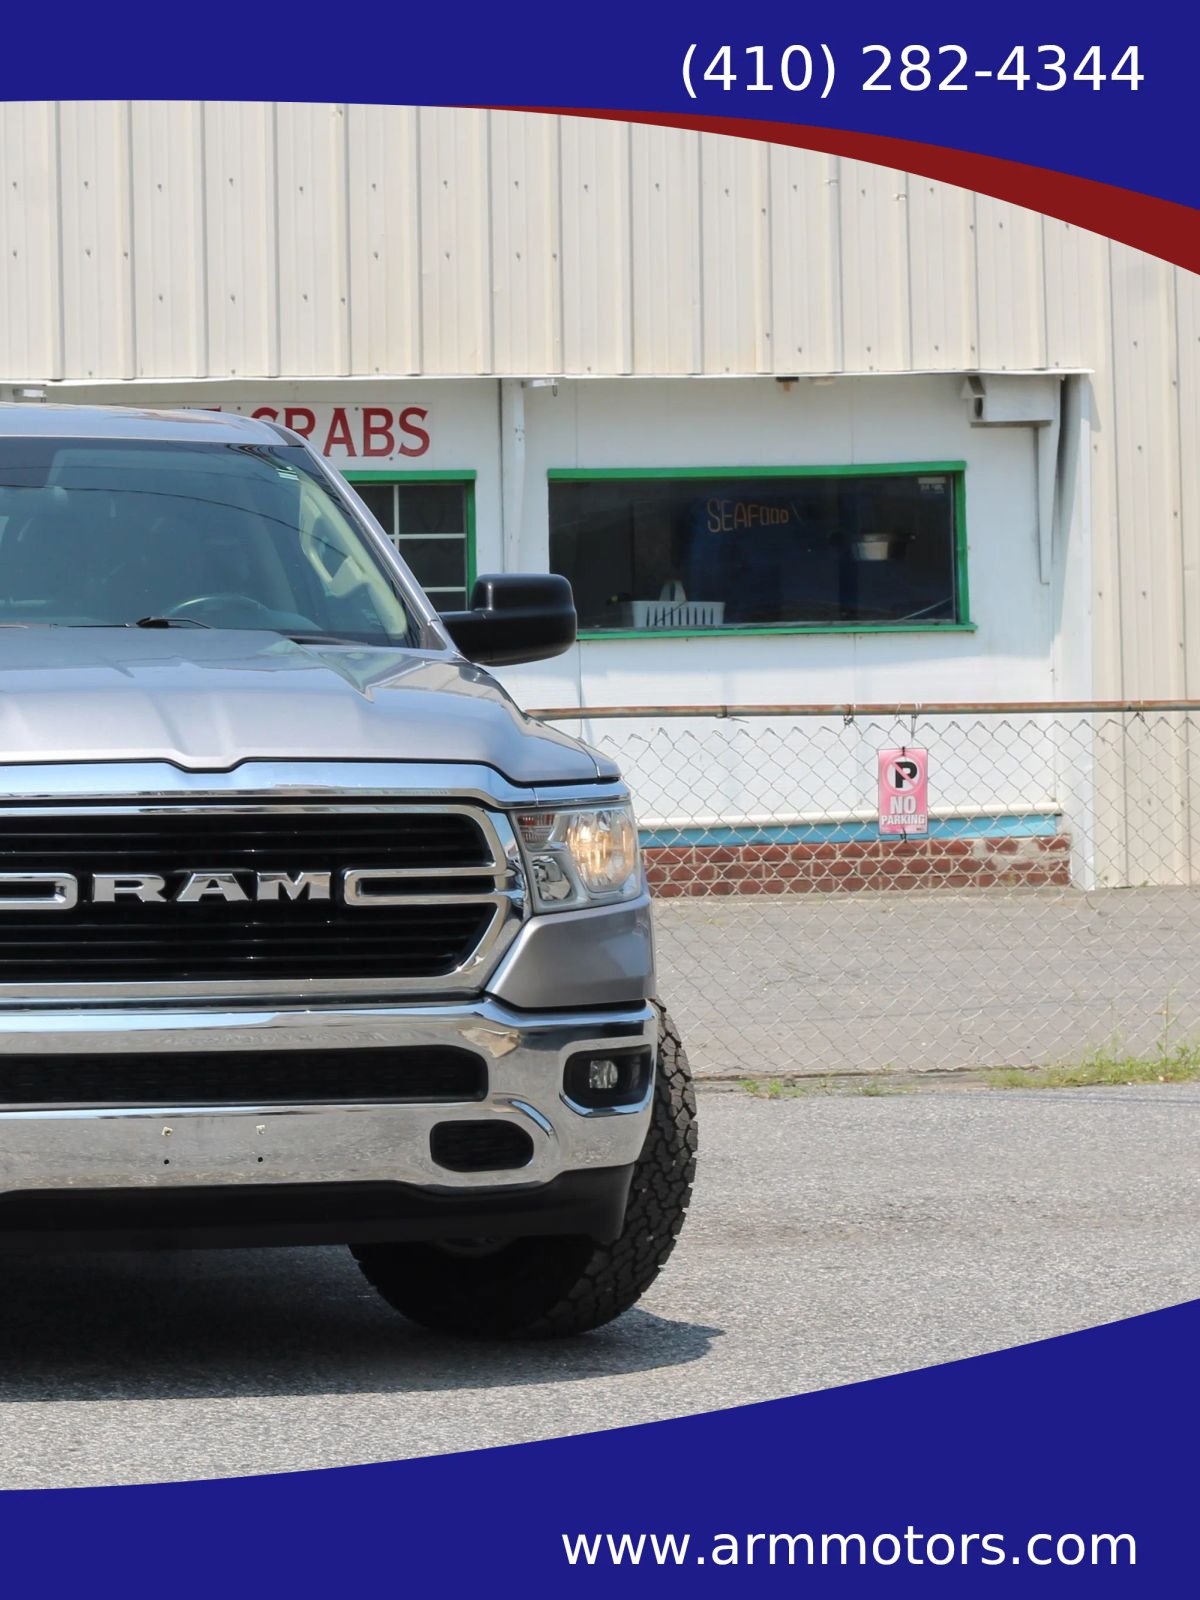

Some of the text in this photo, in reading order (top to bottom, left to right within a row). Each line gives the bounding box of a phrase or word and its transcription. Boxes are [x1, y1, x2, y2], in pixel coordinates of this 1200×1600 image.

[707, 499, 790, 533] SEAFOOD
[890, 795, 917, 815] NO
[881, 814, 927, 825] PARKING
[92, 871, 332, 902] RAM
